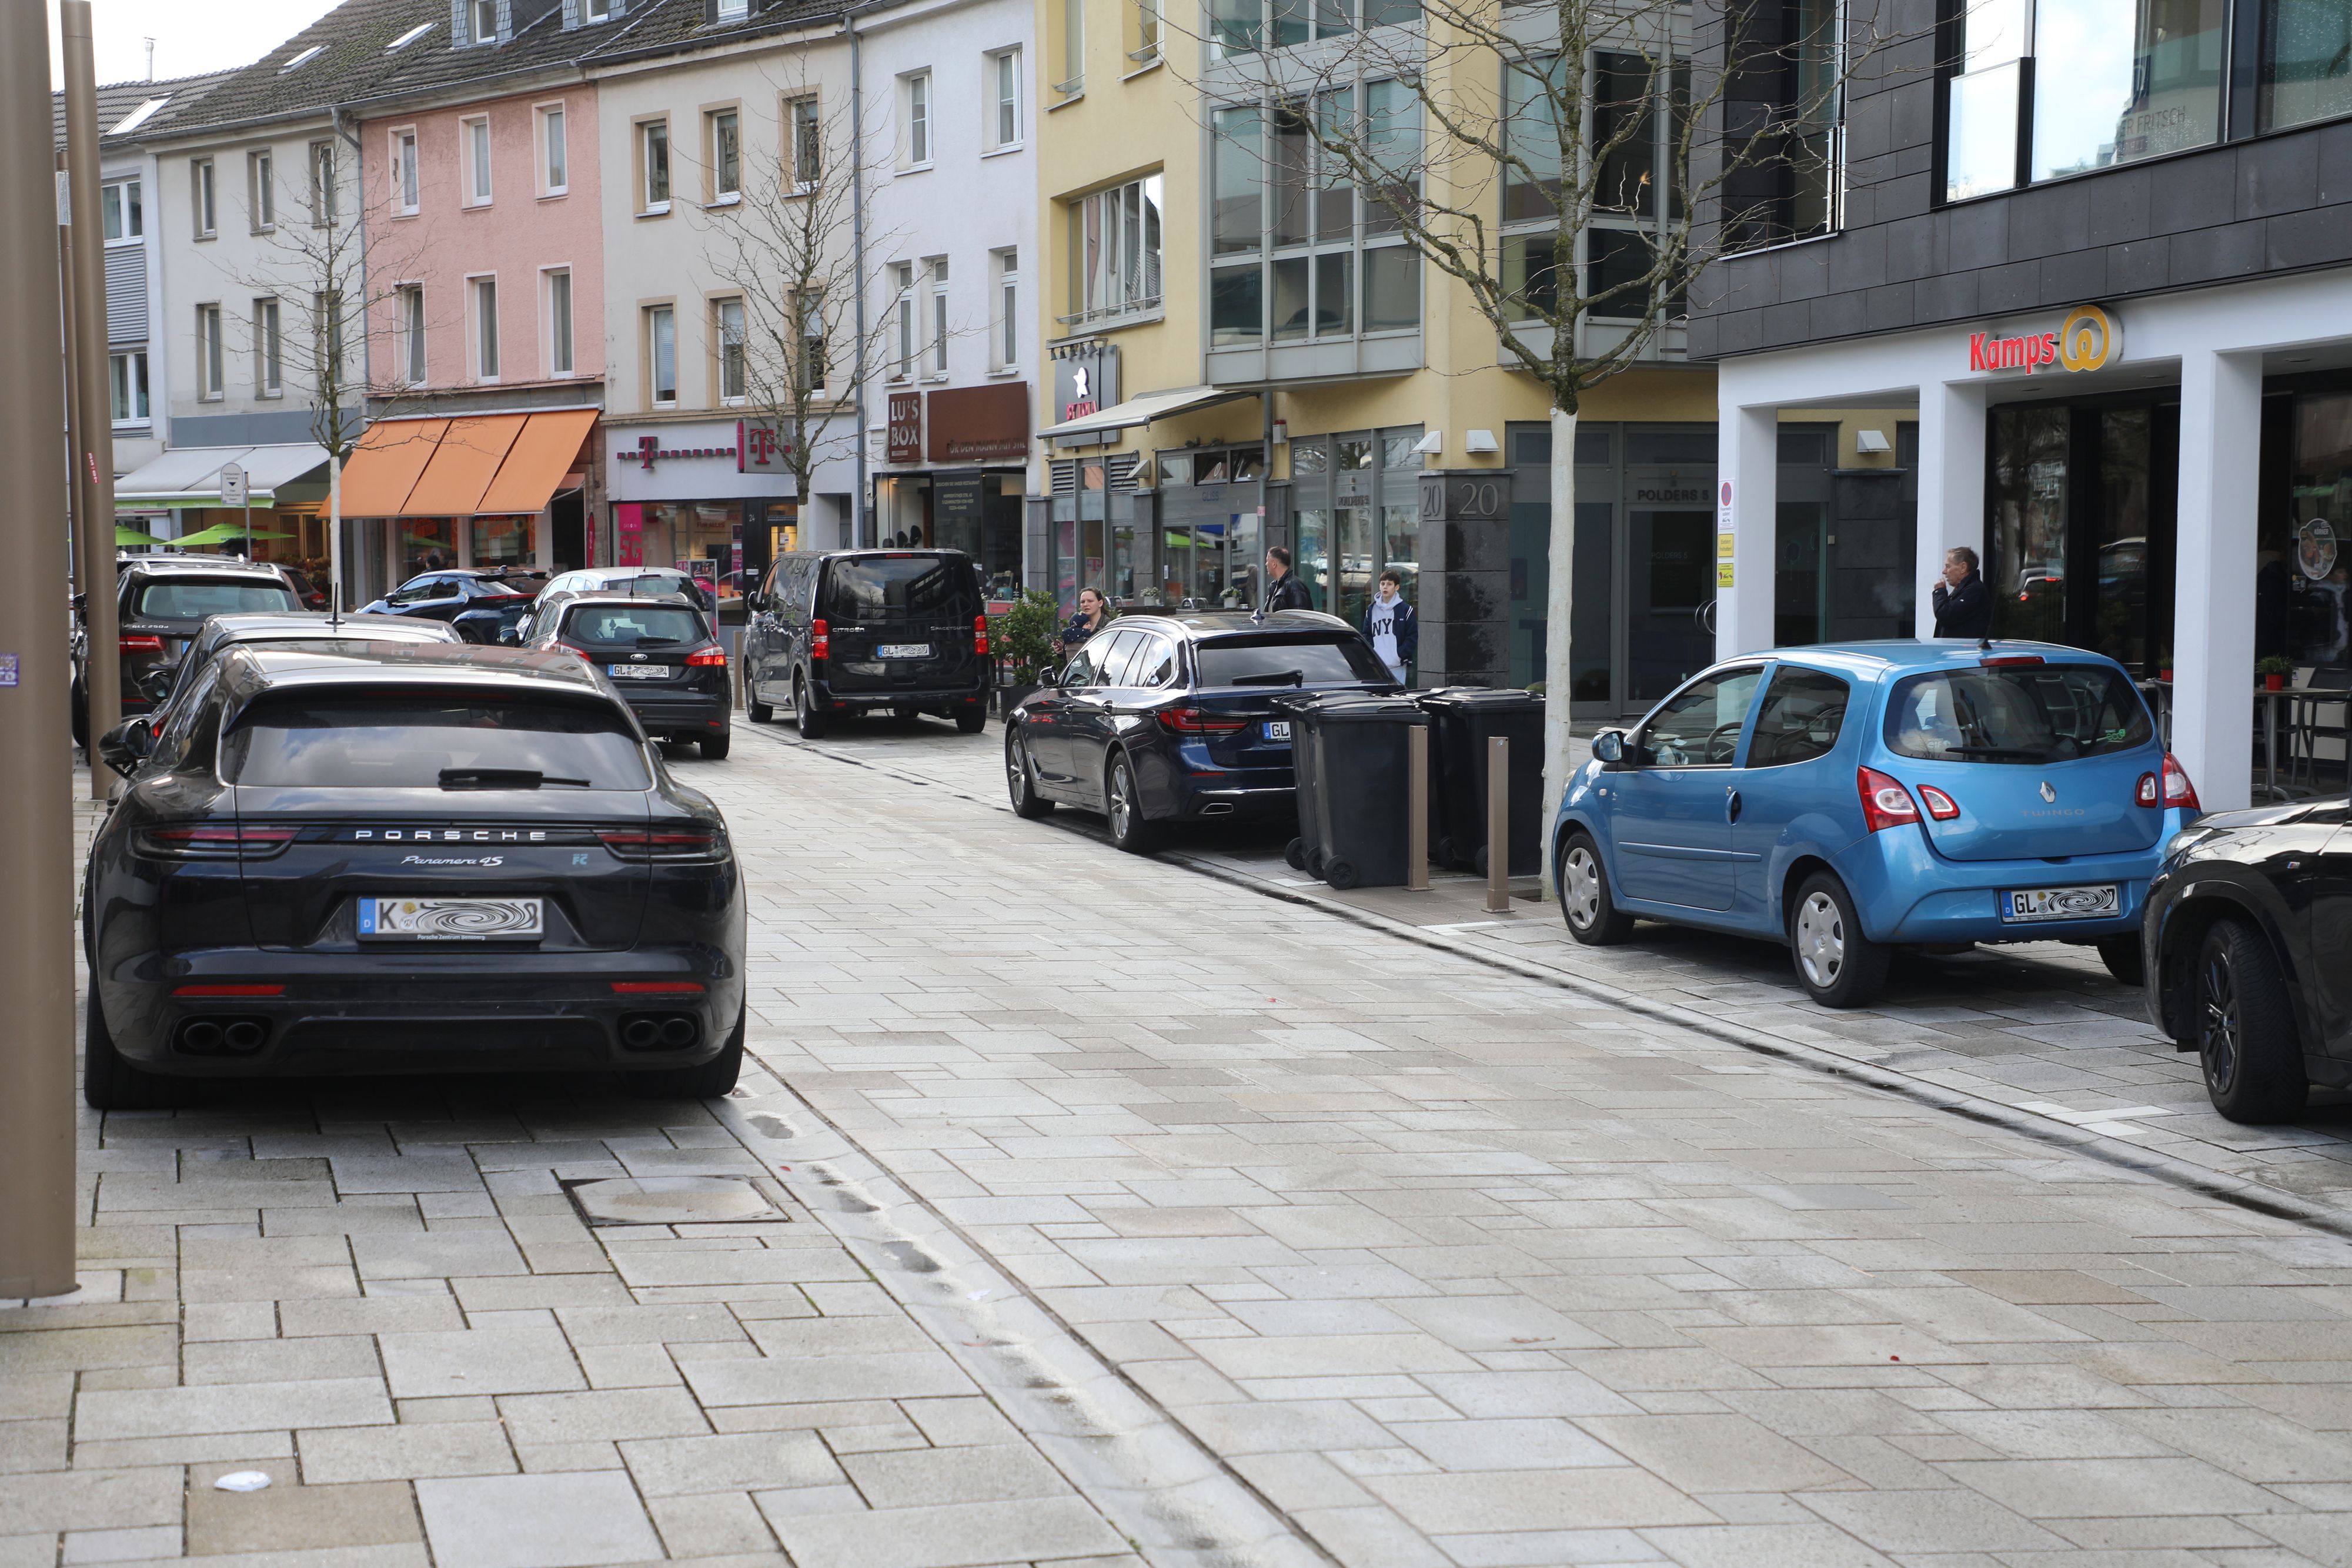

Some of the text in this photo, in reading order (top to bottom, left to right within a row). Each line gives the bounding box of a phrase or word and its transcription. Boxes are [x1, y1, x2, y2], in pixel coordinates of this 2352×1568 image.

[2137, 105, 2186, 133] FRITSCH
[1970, 331, 2056, 376] Kamps
[891, 399, 918, 422] LU'S
[1077, 400, 1098, 418] LOLA
[891, 424, 918, 446] BOX
[960, 441, 974, 453] DEN
[975, 439, 997, 452] MANN
[998, 438, 1011, 451] MIT
[1013, 437, 1026, 449] STIL
[1423, 484, 1441, 516] 20
[1458, 483, 1499, 516] 20
[1638, 489, 1709, 501] POLDERS 5
[749, 514, 755, 522] 24
[619, 534, 643, 567] 5G
[1372, 618, 1393, 636] NY
[883, 647, 894, 656] GL
[614, 666, 626, 675] GL
[1272, 724, 1289, 737] GL
[2020, 808, 2085, 817] TWINGO
[355, 830, 546, 841] PORSCHE
[401, 855, 504, 867] Panamera 4S
[2014, 894, 2036, 914] GL
[379, 902, 397, 930] K
